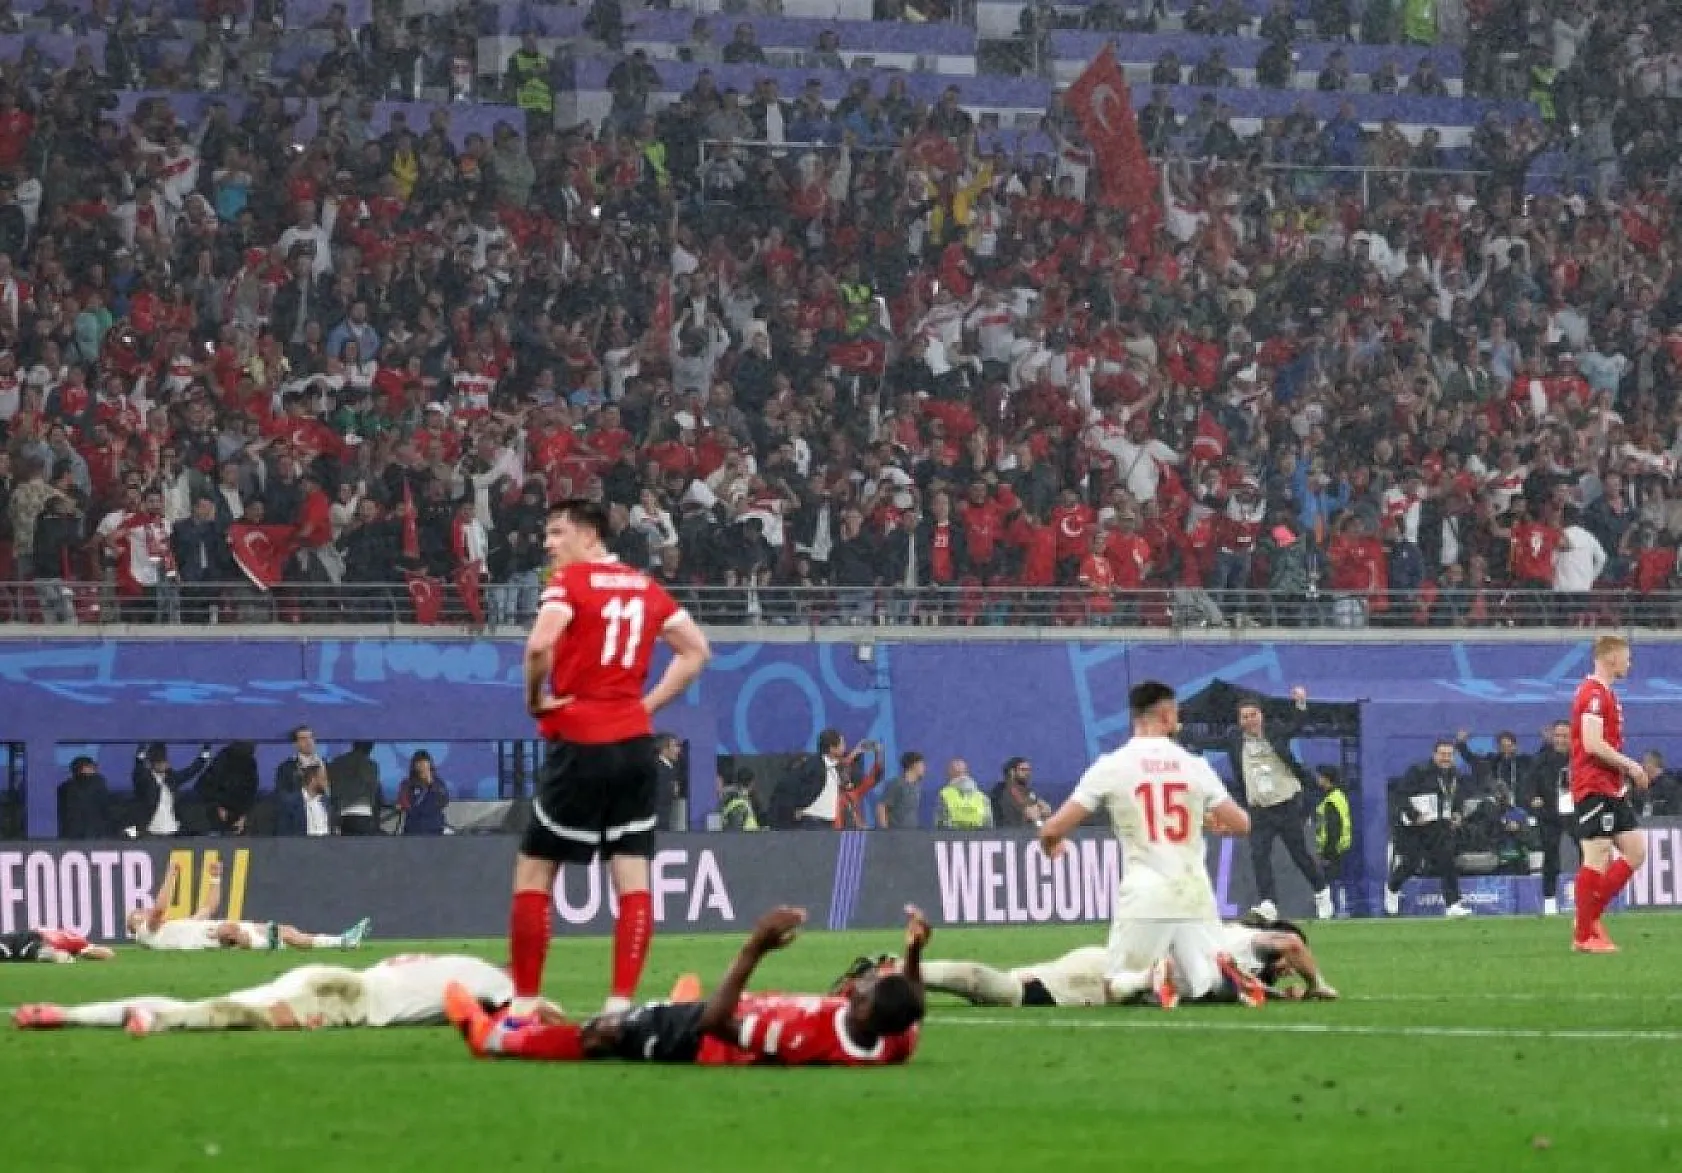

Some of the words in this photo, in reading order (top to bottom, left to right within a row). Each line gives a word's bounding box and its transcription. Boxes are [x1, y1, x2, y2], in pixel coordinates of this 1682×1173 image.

[601, 597, 646, 669] 11
[1134, 782, 1192, 844] 15
[553, 849, 735, 923] UFA
[935, 839, 1122, 922] WELCOM
